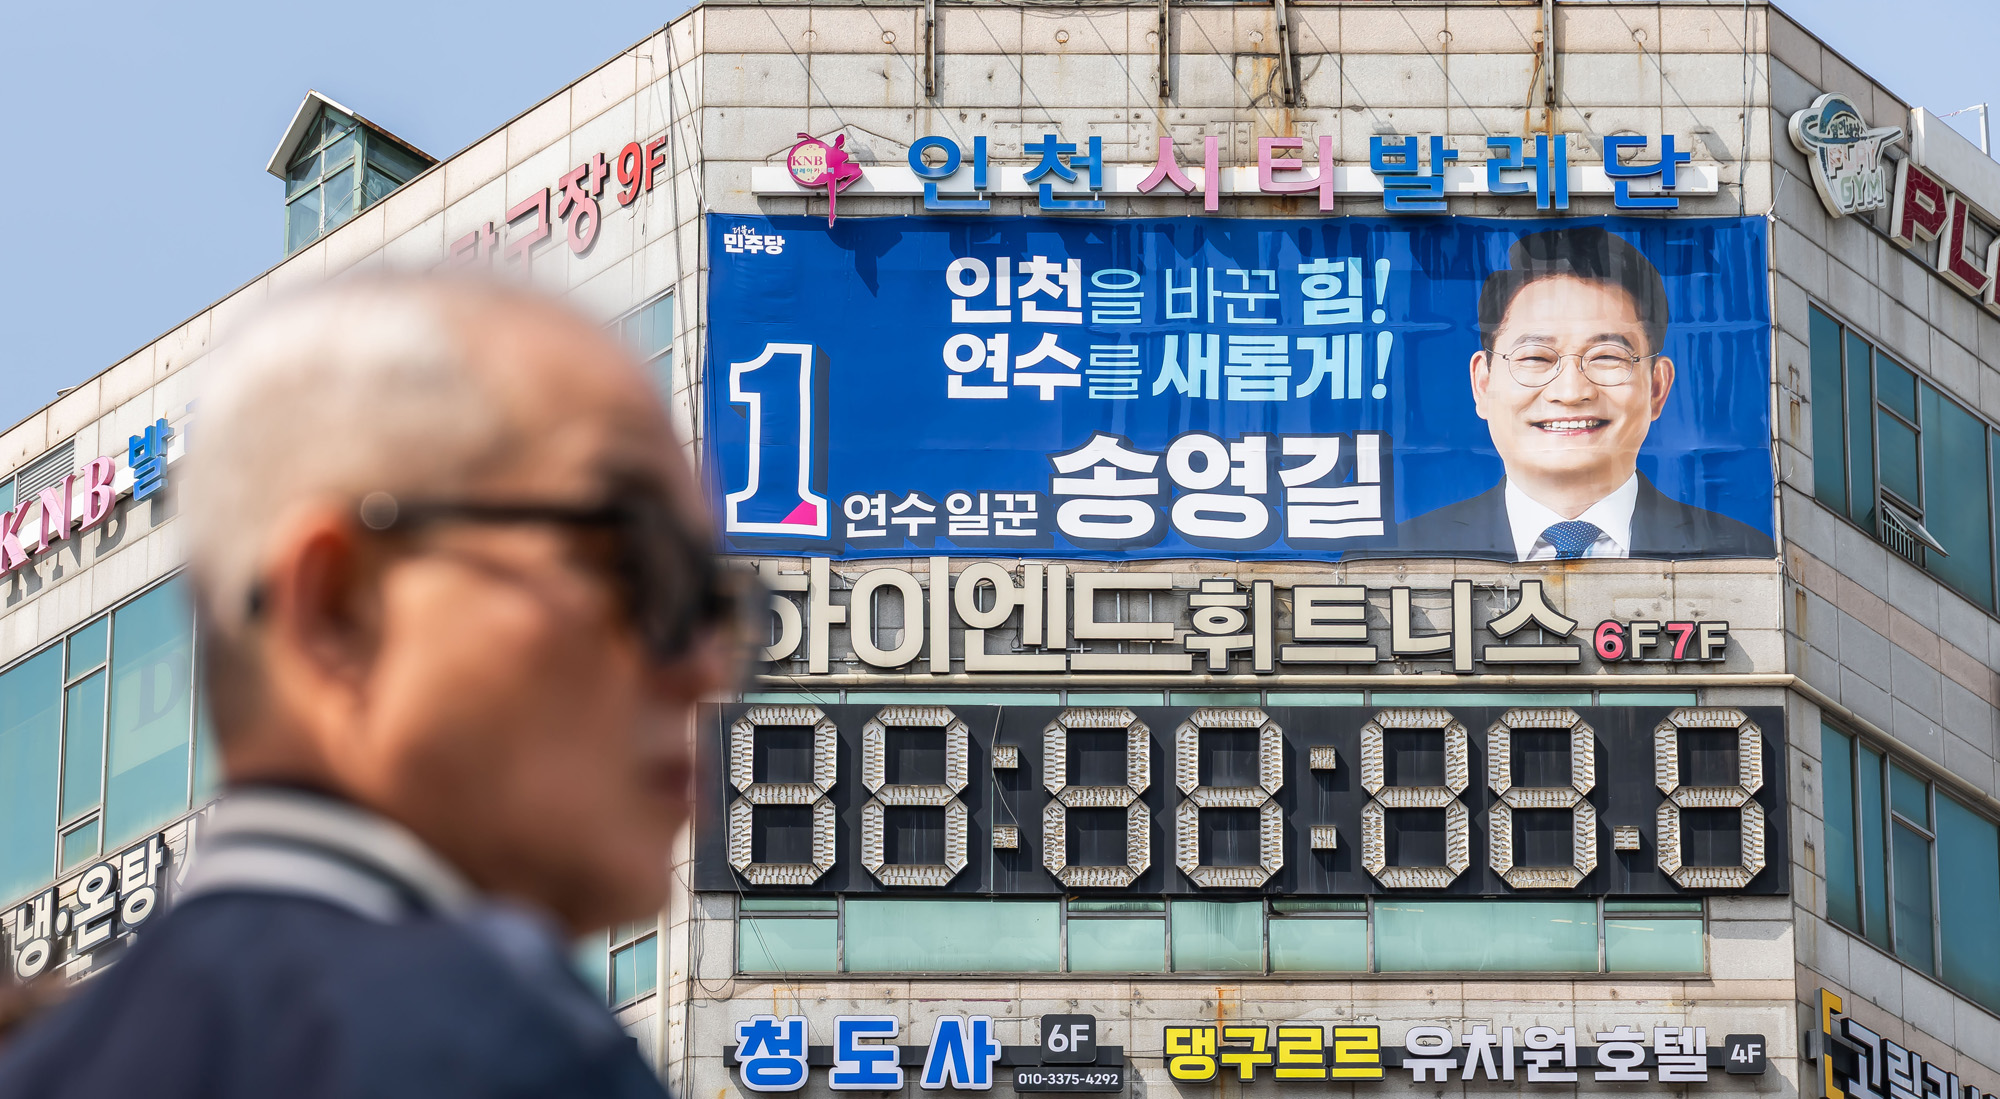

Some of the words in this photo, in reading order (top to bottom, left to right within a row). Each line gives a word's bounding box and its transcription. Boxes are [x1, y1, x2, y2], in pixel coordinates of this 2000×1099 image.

[617, 134, 668, 208] 9F
[792, 155, 823, 166] KNB
[1840, 174, 1883, 204] GYM
[723, 233, 786, 255] 민주당
[732, 224, 755, 237] 더불어
[1891, 157, 2000, 317] PL
[945, 255, 1144, 324] 인천을
[1165, 266, 1280, 325] 바꾼
[1298, 256, 1391, 326] 힘!
[942, 332, 1143, 401] 연수를
[1152, 330, 1394, 402] 새롭게!
[725, 342, 828, 537] 1
[0, 455, 116, 578] KNB
[844, 493, 936, 537] 연수
[945, 493, 1039, 537] 일꾼
[1052, 434, 1385, 540] 송영길
[1047, 1024, 1090, 1053] 6F
[1163, 1025, 1386, 1083] 댕구르르
[1402, 1025, 1579, 1083] 유치원
[1594, 1025, 1708, 1084] 호텔
[1730, 1043, 1762, 1064] 4F
[1018, 1072, 1119, 1086] 010-3375-4292
